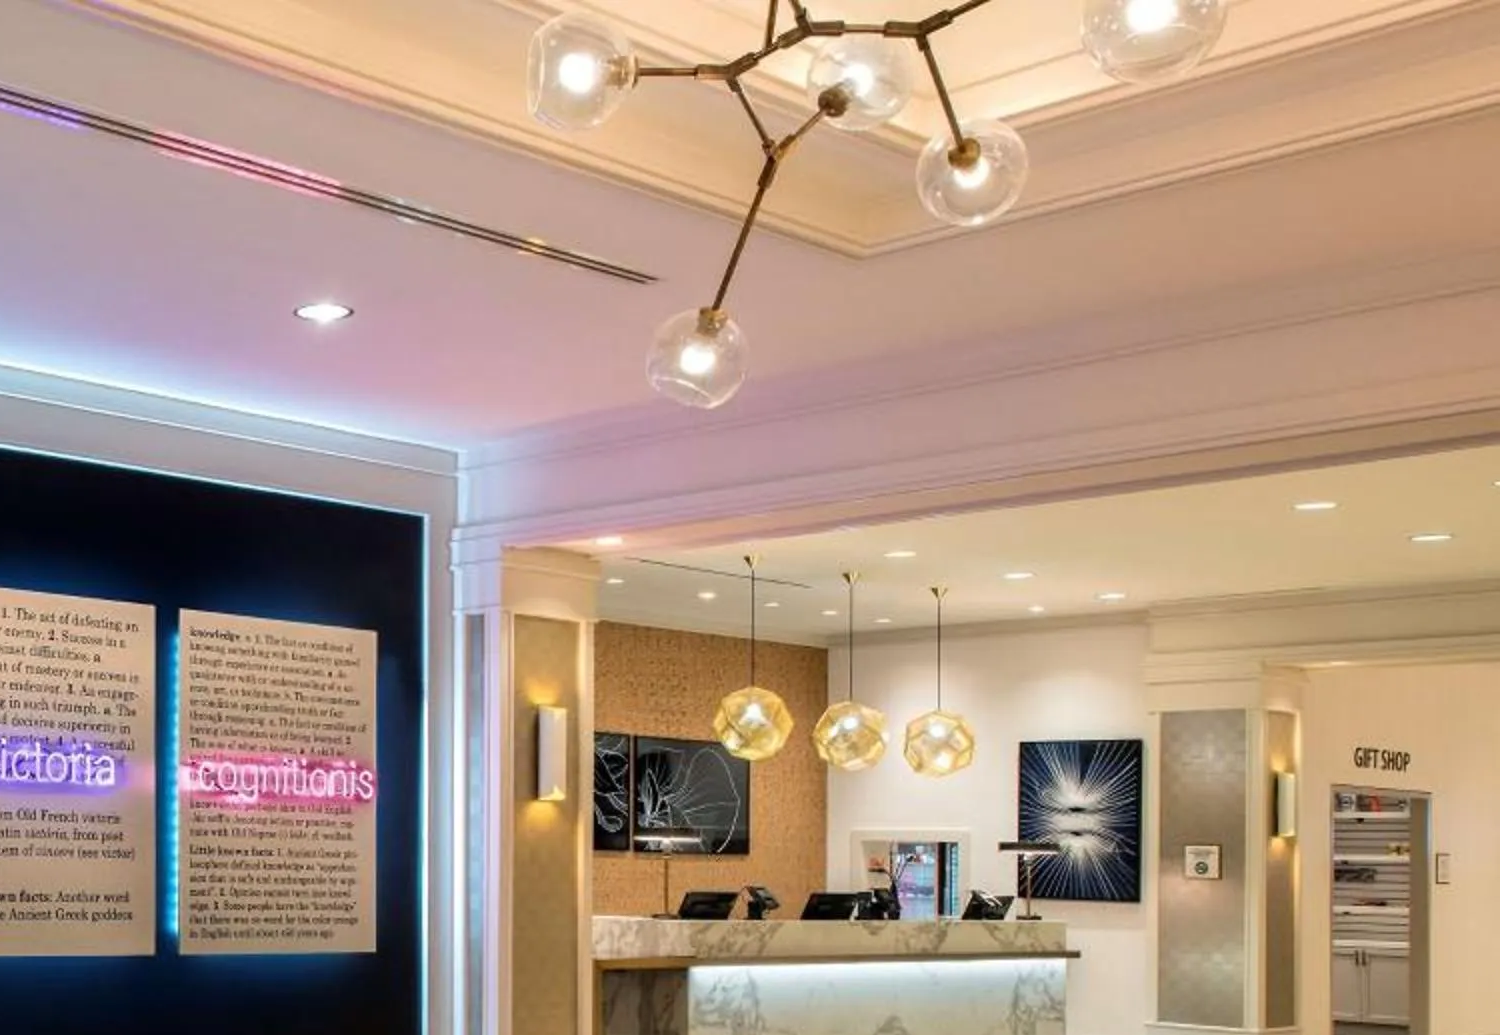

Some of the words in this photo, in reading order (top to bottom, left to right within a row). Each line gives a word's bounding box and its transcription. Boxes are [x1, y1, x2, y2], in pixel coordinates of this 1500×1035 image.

[1354, 747, 1379, 769] GIFT
[1381, 749, 1411, 773] SHOP
[199, 757, 374, 803] cognitionis
